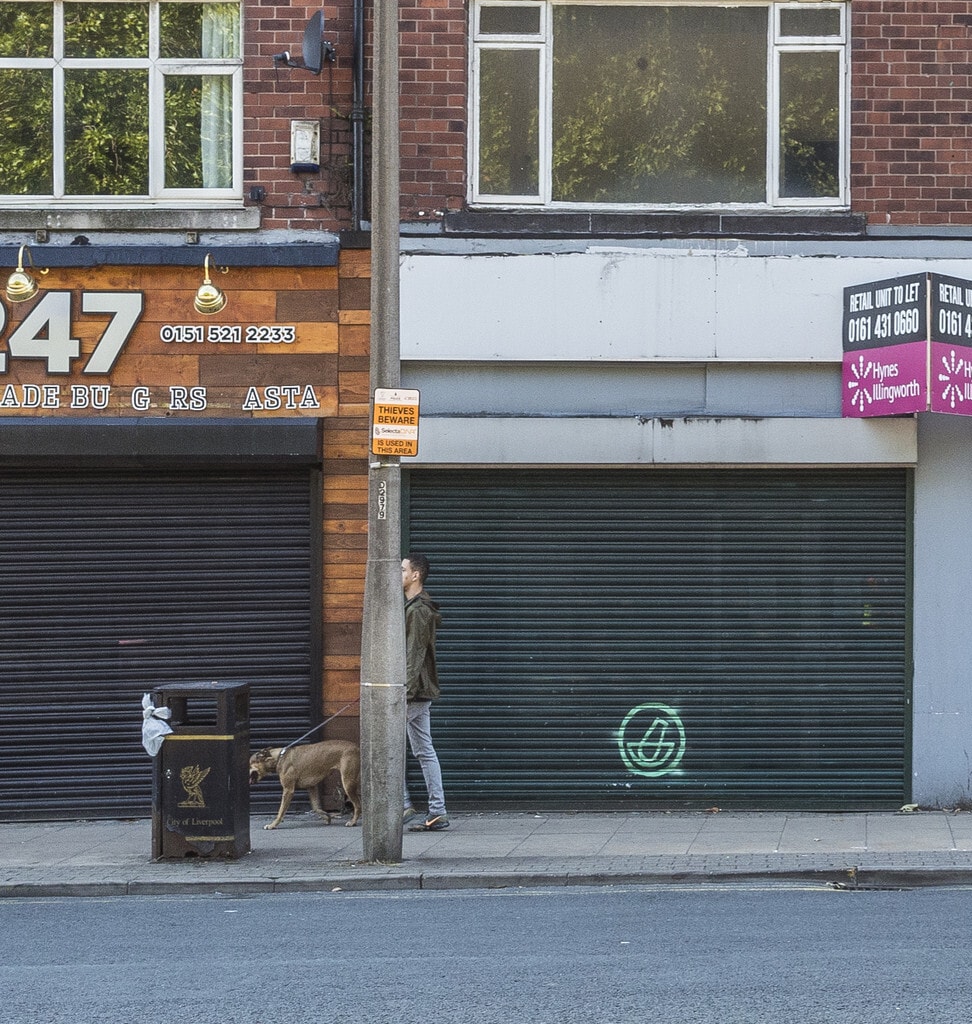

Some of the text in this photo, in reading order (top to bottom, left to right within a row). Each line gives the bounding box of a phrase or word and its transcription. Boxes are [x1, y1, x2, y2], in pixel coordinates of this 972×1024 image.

[850, 282, 920, 313] RETAIL UNIT TO LET
[939, 283, 963, 306] RETAIL
[0, 291, 145, 375] 47
[848, 307, 919, 343] 0161 431 0660
[938, 308, 962, 337] 0161
[160, 325, 296, 343] 0151 521 2233
[872, 361, 899, 382] Hynes
[872, 379, 920, 403] Illingworth
[378, 406, 415, 416] THIEVES
[378, 415, 416, 425] BEWARE
[377, 446, 412, 455] THIS AREA
[385, 439, 404, 447] USED
[167, 817, 224, 827] City of Liverpool
